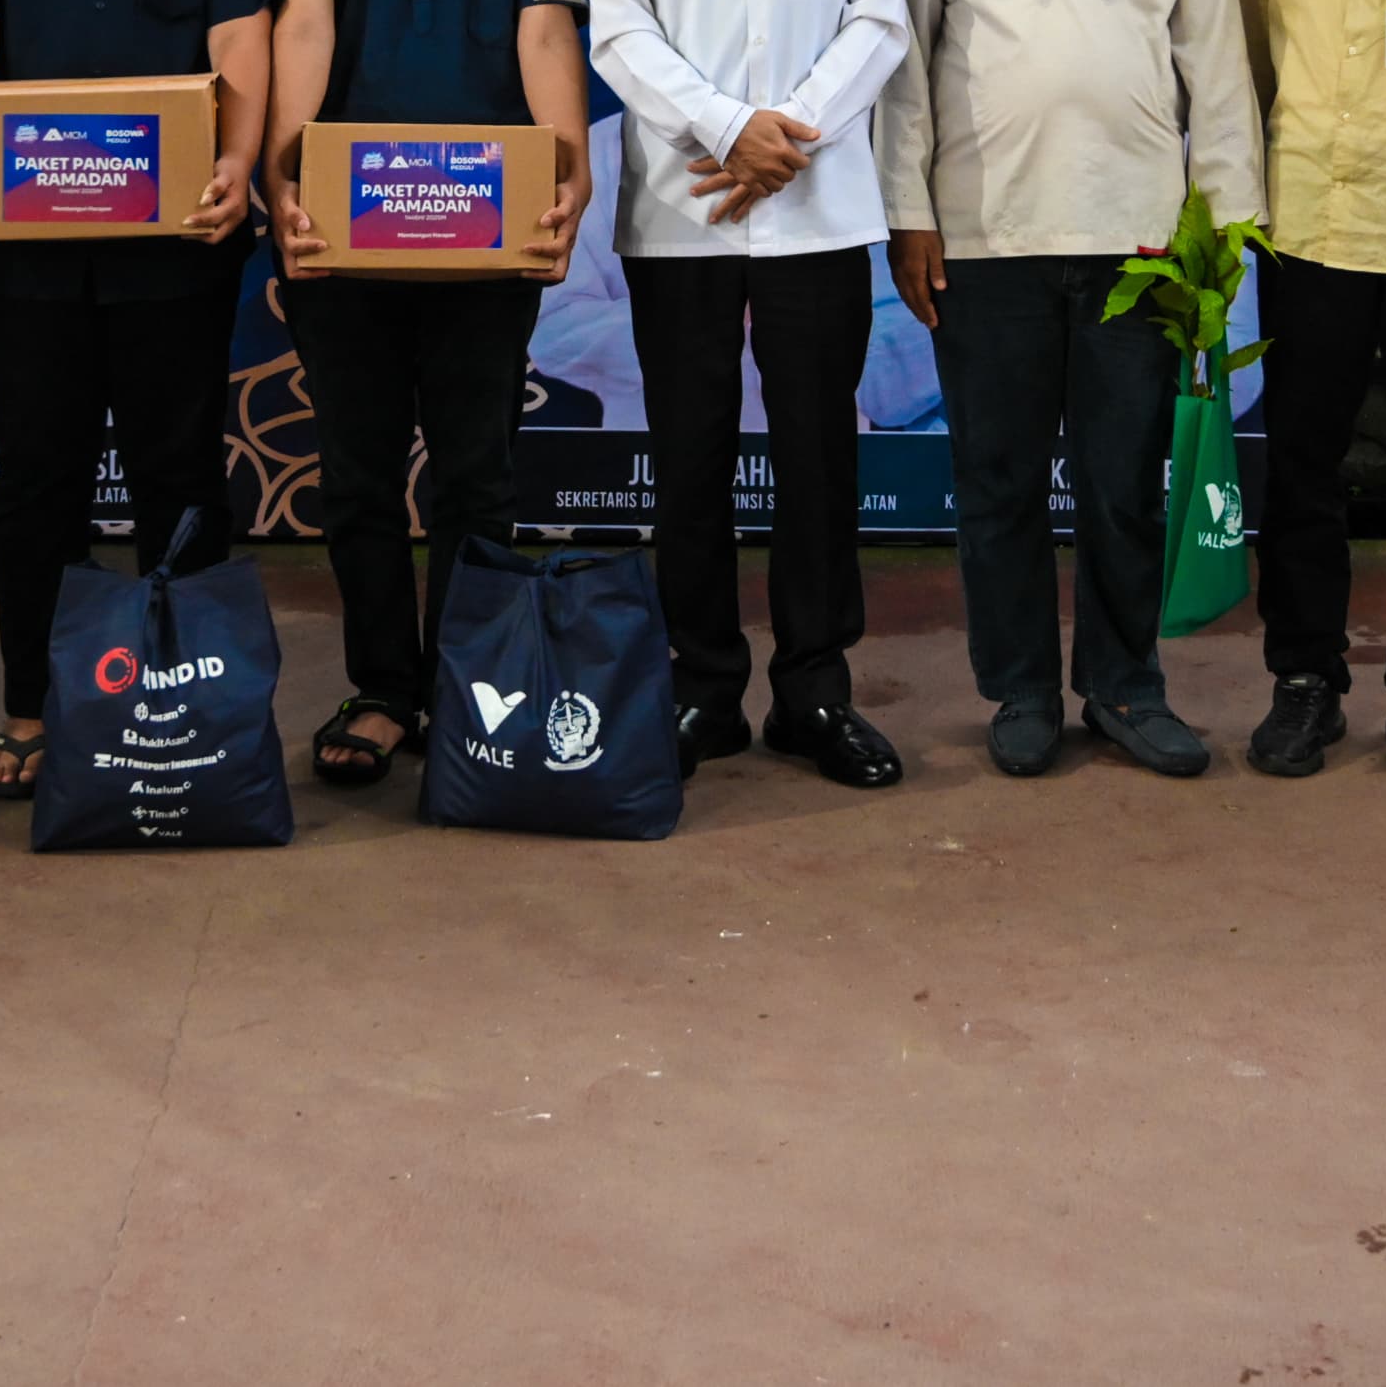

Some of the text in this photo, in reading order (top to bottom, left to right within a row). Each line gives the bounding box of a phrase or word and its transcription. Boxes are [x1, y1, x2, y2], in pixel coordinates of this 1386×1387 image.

[105, 129, 144, 137] BOSOWA
[14, 157, 148, 169] PAKET PANGAN
[450, 156, 487, 164] BOSOWA
[36, 172, 126, 185] RAMADAN
[361, 184, 491, 196] PAKET PANGAN
[382, 199, 470, 211] RAMADAN
[555, 491, 639, 510] SEKRETARIS
[196, 656, 223, 678] ID
[465, 736, 513, 768] VALE
[112, 756, 125, 767] PT
[145, 784, 183, 794] Inalum
